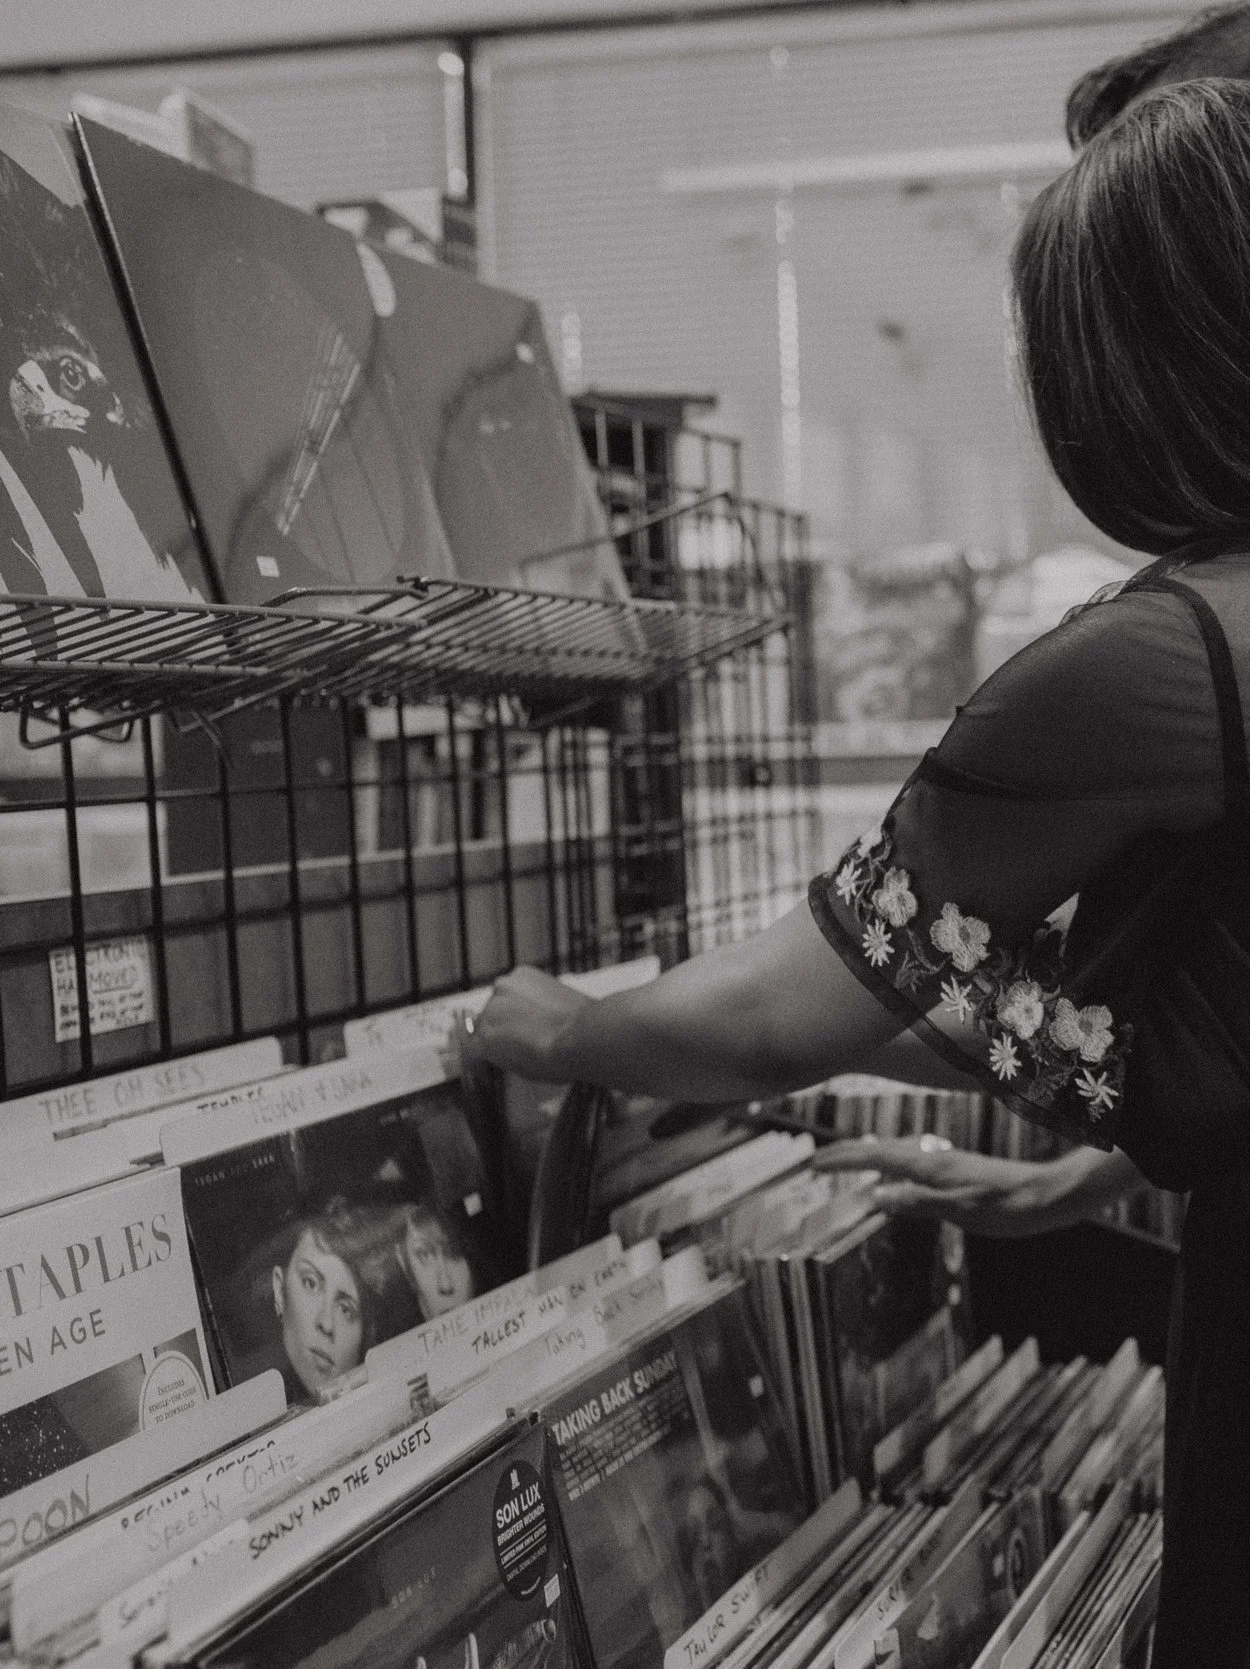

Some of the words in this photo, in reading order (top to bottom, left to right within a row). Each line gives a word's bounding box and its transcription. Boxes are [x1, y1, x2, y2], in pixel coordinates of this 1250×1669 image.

[39, 1087, 96, 1124] THEE
[0, 1213, 172, 1319] TAPLES
[0, 1336, 35, 1377] EN
[50, 1308, 106, 1355] AGE
[417, 1316, 468, 1355] TAME
[471, 1311, 526, 1355] TALLEST
[551, 1399, 601, 1446] TAKING
[601, 1377, 635, 1415] BACK
[633, 1351, 678, 1394] SUNDAY
[243, 1452, 297, 1493] Ortiz
[249, 1505, 304, 1560] SONNY
[311, 1486, 341, 1515] AND
[343, 1466, 370, 1494] THE
[374, 1421, 432, 1476] SUNSETS
[496, 1497, 520, 1529] SON
[520, 1481, 541, 1511] LUX
[497, 1519, 525, 1546] BRIGHTER
[523, 1502, 545, 1528] WOUNDS
